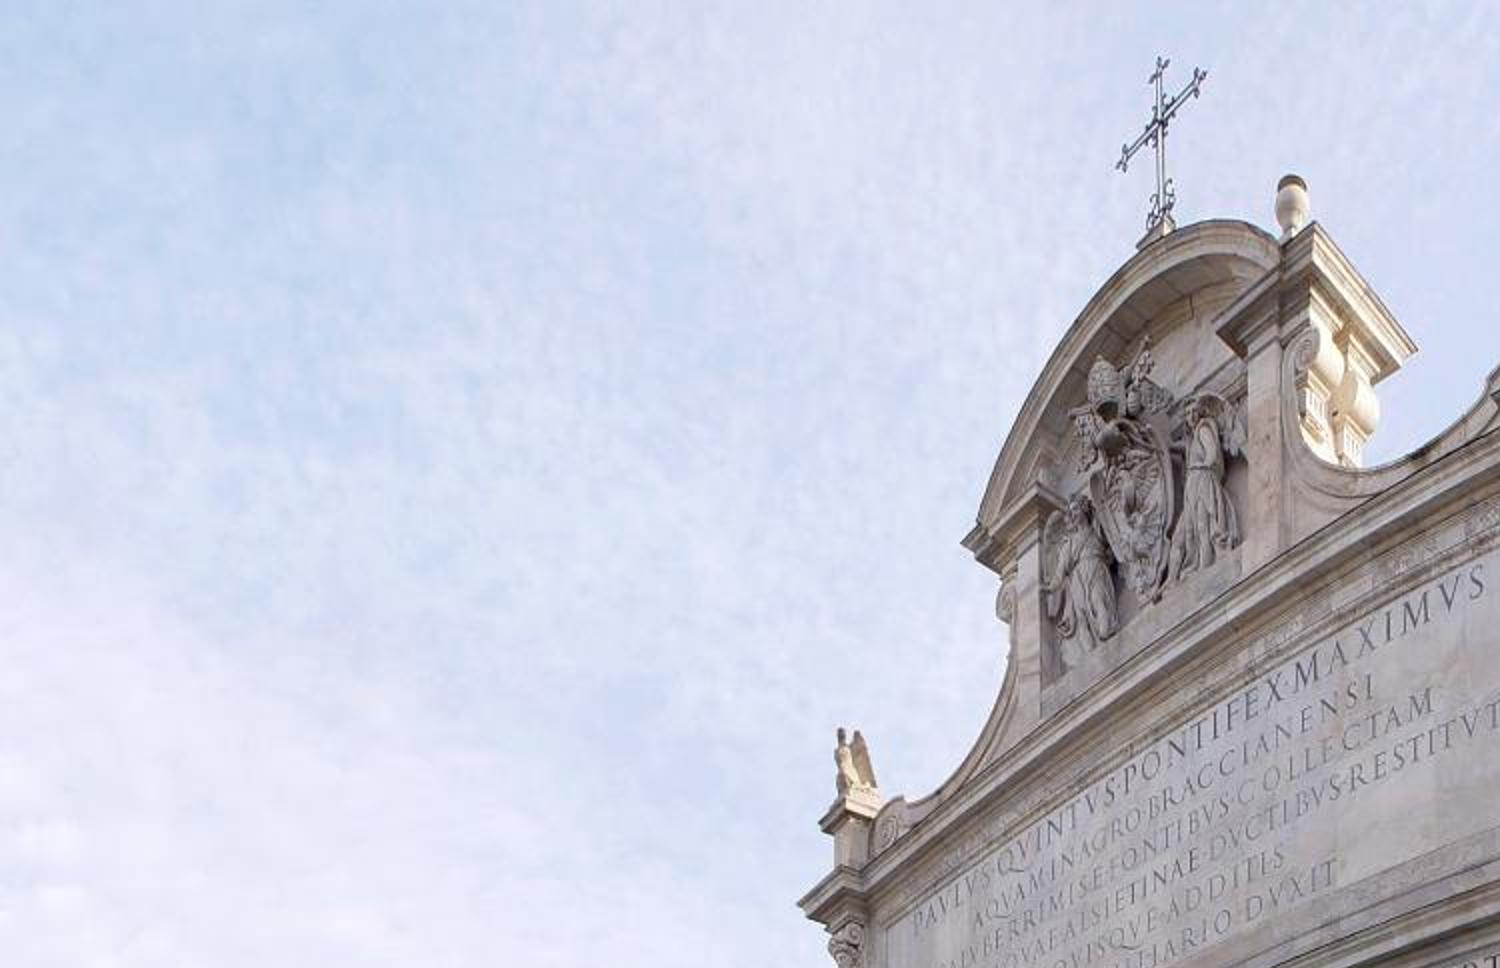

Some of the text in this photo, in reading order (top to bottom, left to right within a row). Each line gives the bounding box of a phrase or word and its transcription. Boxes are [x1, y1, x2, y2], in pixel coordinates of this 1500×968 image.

[997, 779, 1116, 874] QVINTVS
[1124, 672, 1281, 795] PONTIFEX
[1293, 564, 1486, 695] MAXIMVS
[1148, 674, 1374, 822] BRACCIANENSI
[1208, 773, 1342, 861] DVCTIBVS
[1167, 846, 1284, 918] ADDITIS
[1246, 859, 1338, 922] DVXIT
